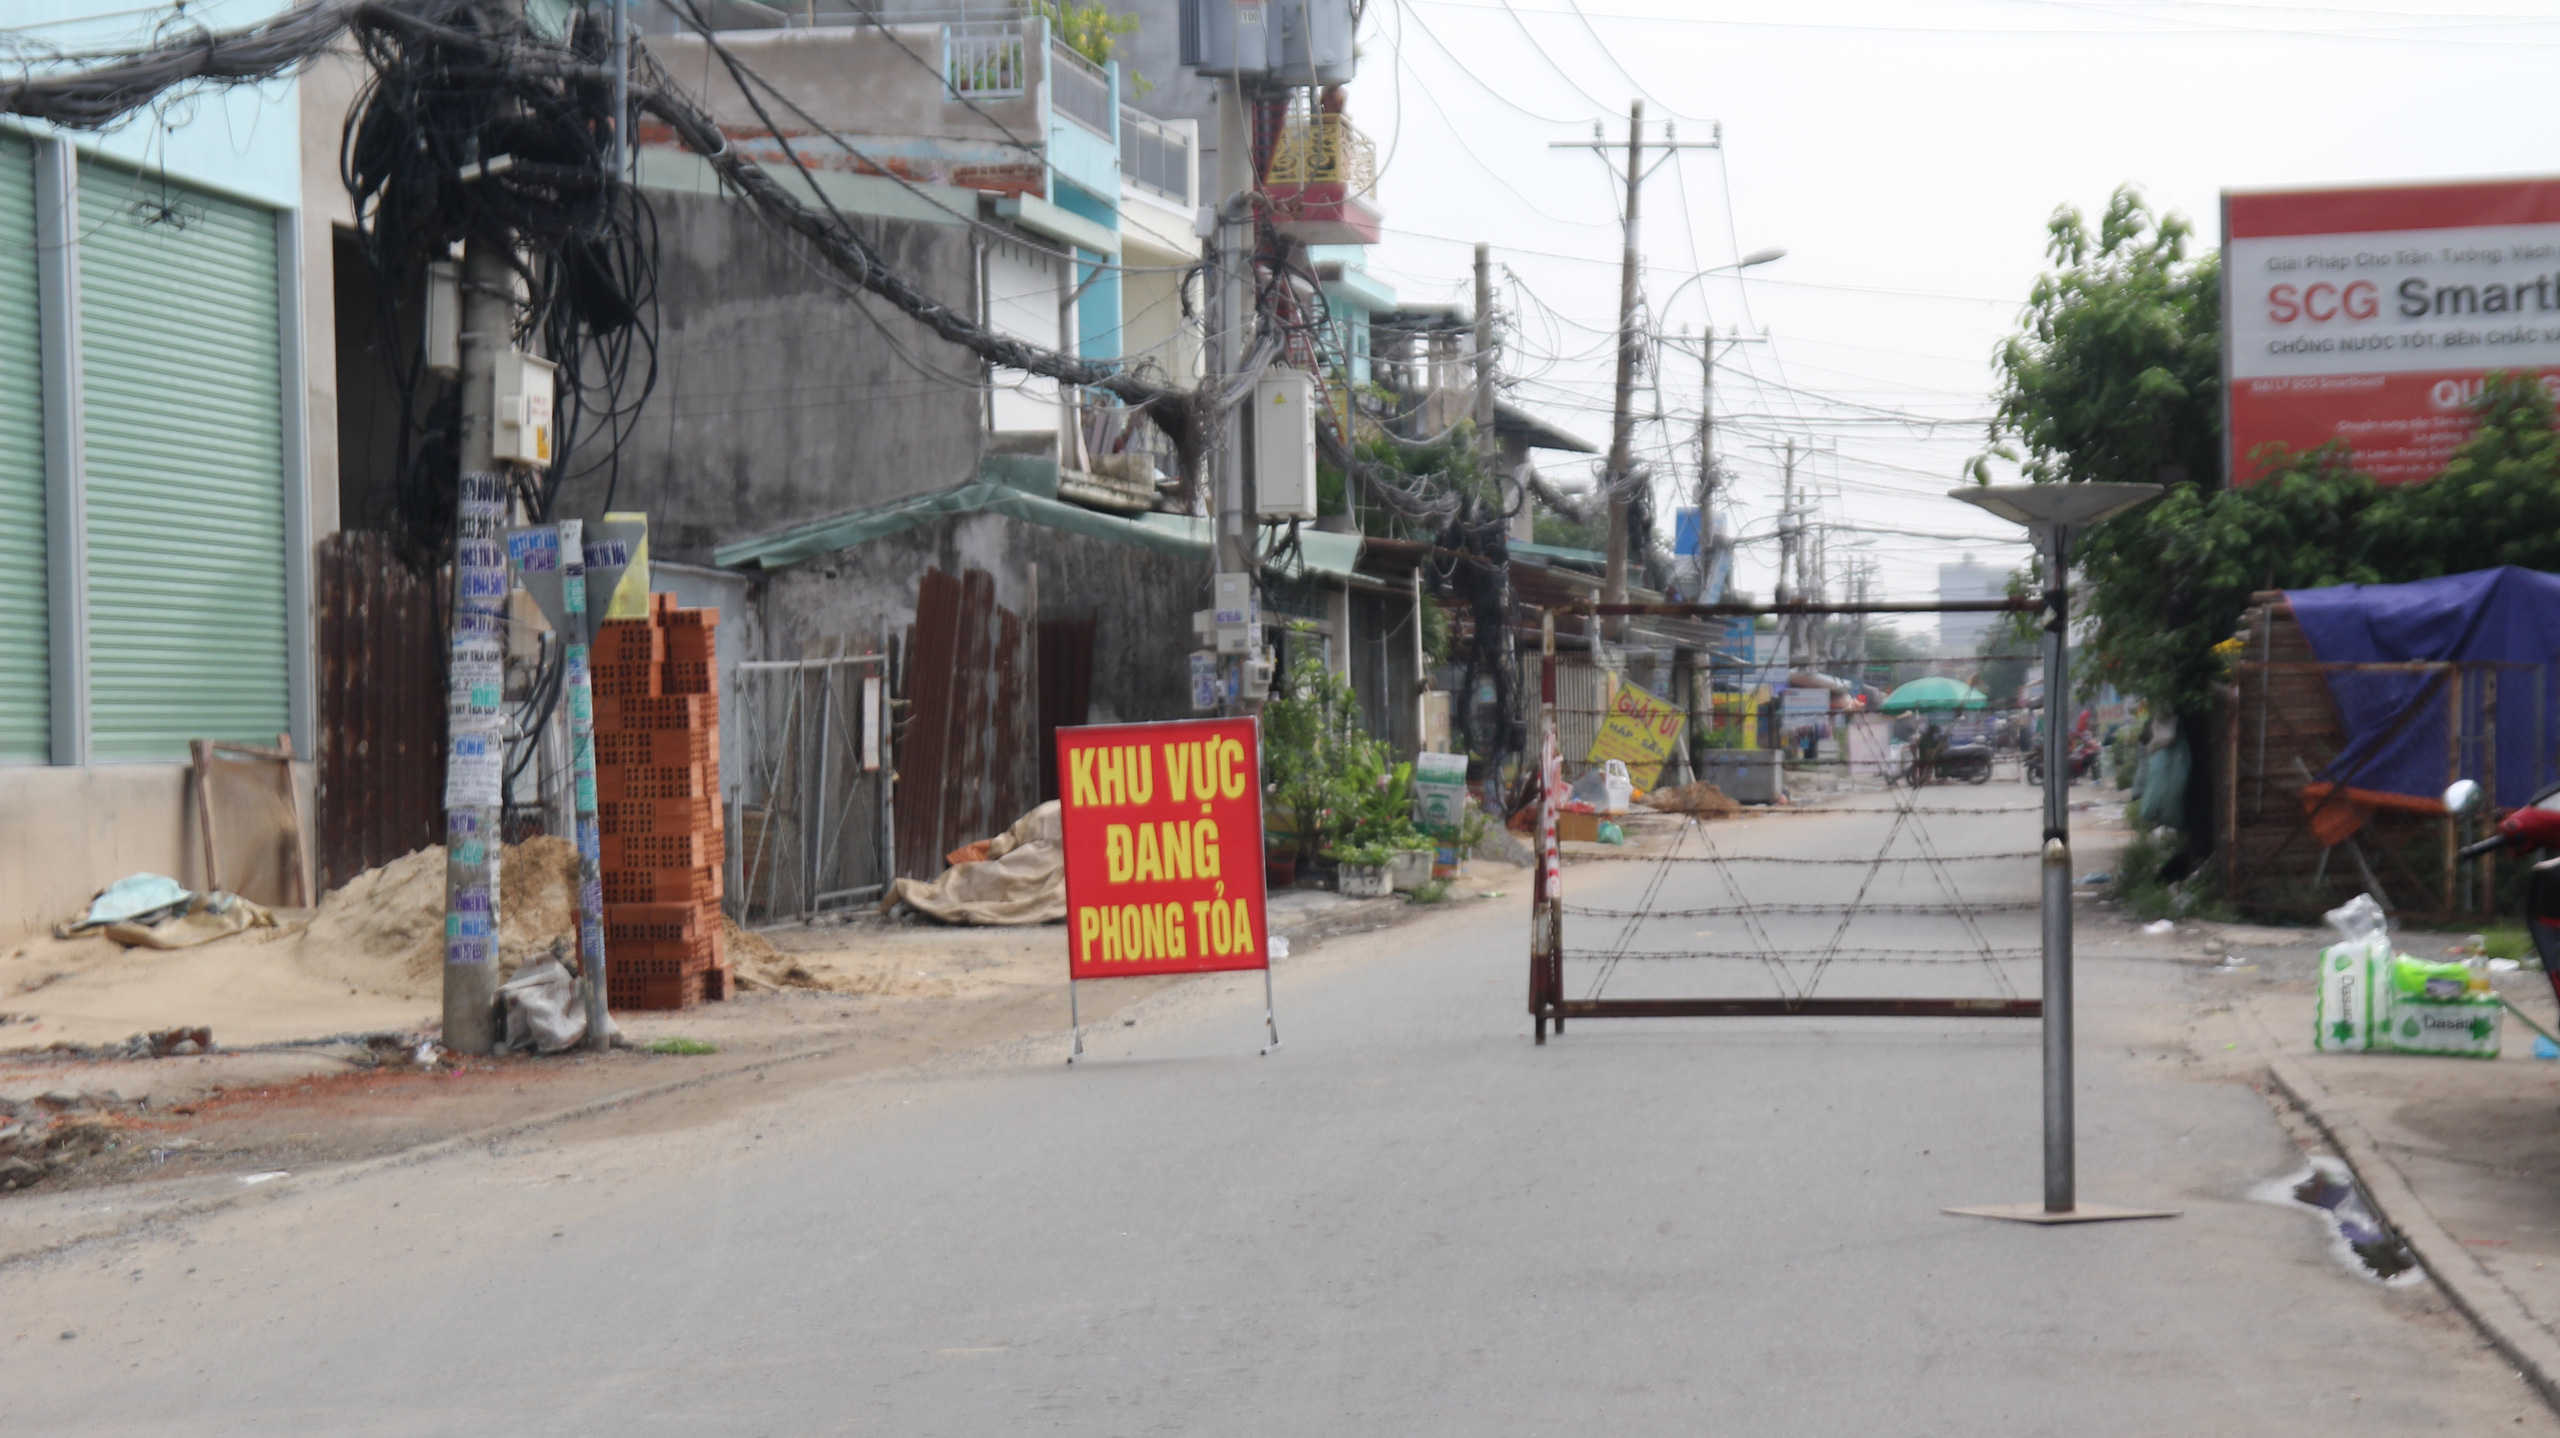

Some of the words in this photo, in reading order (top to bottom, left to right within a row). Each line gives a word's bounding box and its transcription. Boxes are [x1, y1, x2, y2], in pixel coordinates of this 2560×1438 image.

[2356, 252, 2391, 267] Cho
[2268, 280, 2379, 323] SCG
[2269, 333, 2335, 355] CHỐNG
[1069, 745, 1154, 807] KHU
[1163, 733, 1247, 814] VỰC
[1105, 817, 1222, 883] ĐANG
[1079, 900, 1188, 962] PHONG
[1192, 879, 1256, 957] TỎA
